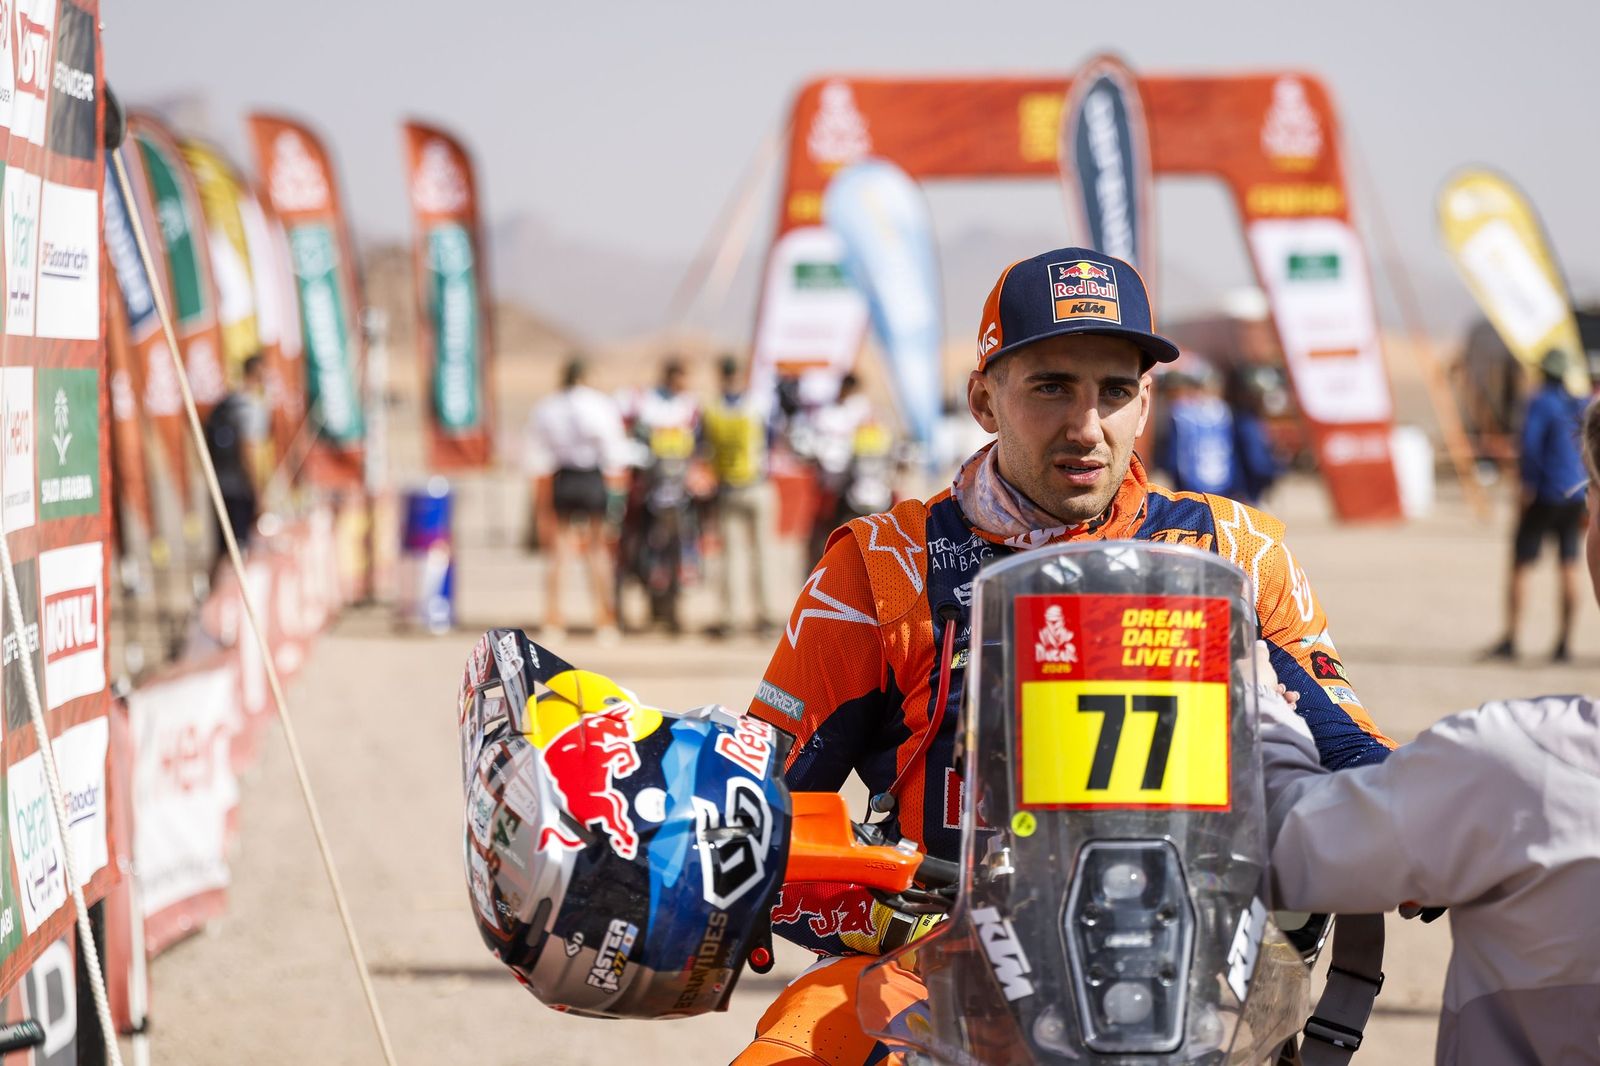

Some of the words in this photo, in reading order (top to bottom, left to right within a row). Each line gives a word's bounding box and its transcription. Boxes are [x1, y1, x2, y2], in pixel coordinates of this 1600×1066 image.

[1054, 280, 1086, 298] Red
[1087, 280, 1117, 299] Bull
[1070, 301, 1106, 315] KTM
[932, 546, 994, 574] AIRBAG
[46, 595, 96, 657] MOTUL
[1121, 608, 1208, 629] DREAM.
[1121, 628, 1189, 647] DARE.
[1121, 648, 1174, 667] LIVE
[1175, 649, 1201, 667] IT.
[757, 682, 800, 718] OTOREX
[1077, 695, 1178, 791] 77
[587, 918, 628, 990] FASTER
[672, 910, 730, 1009] BENAVIDES
[970, 906, 1035, 1002] KTM
